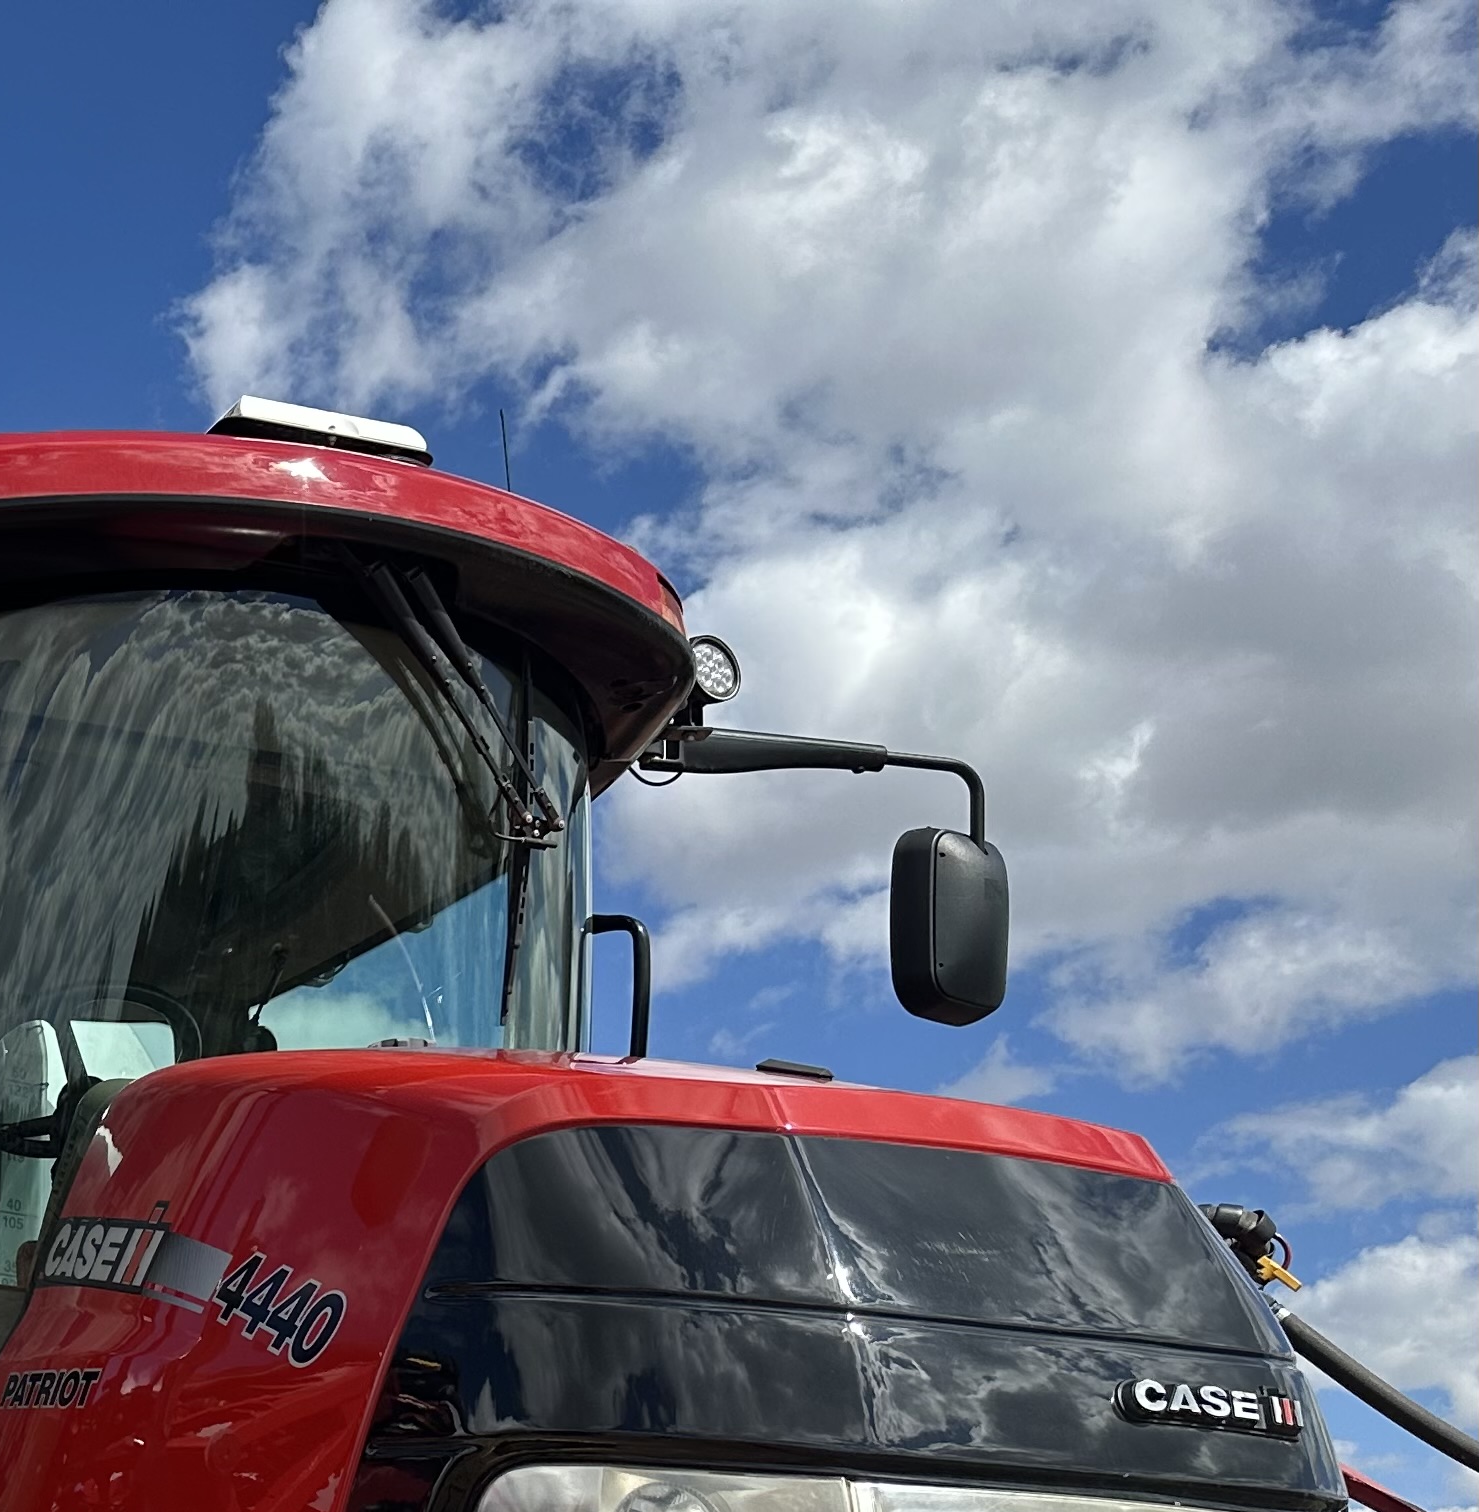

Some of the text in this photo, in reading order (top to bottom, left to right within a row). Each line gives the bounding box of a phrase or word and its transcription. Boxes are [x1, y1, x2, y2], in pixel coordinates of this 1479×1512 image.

[2, 1216, 25, 1231] 105
[6, 1197, 22, 1211] 40
[44, 1222, 124, 1284] CASE
[212, 1251, 348, 1368] 4440
[0, 1368, 103, 1410] PATRIOT
[1134, 1378, 1260, 1421] CASE
